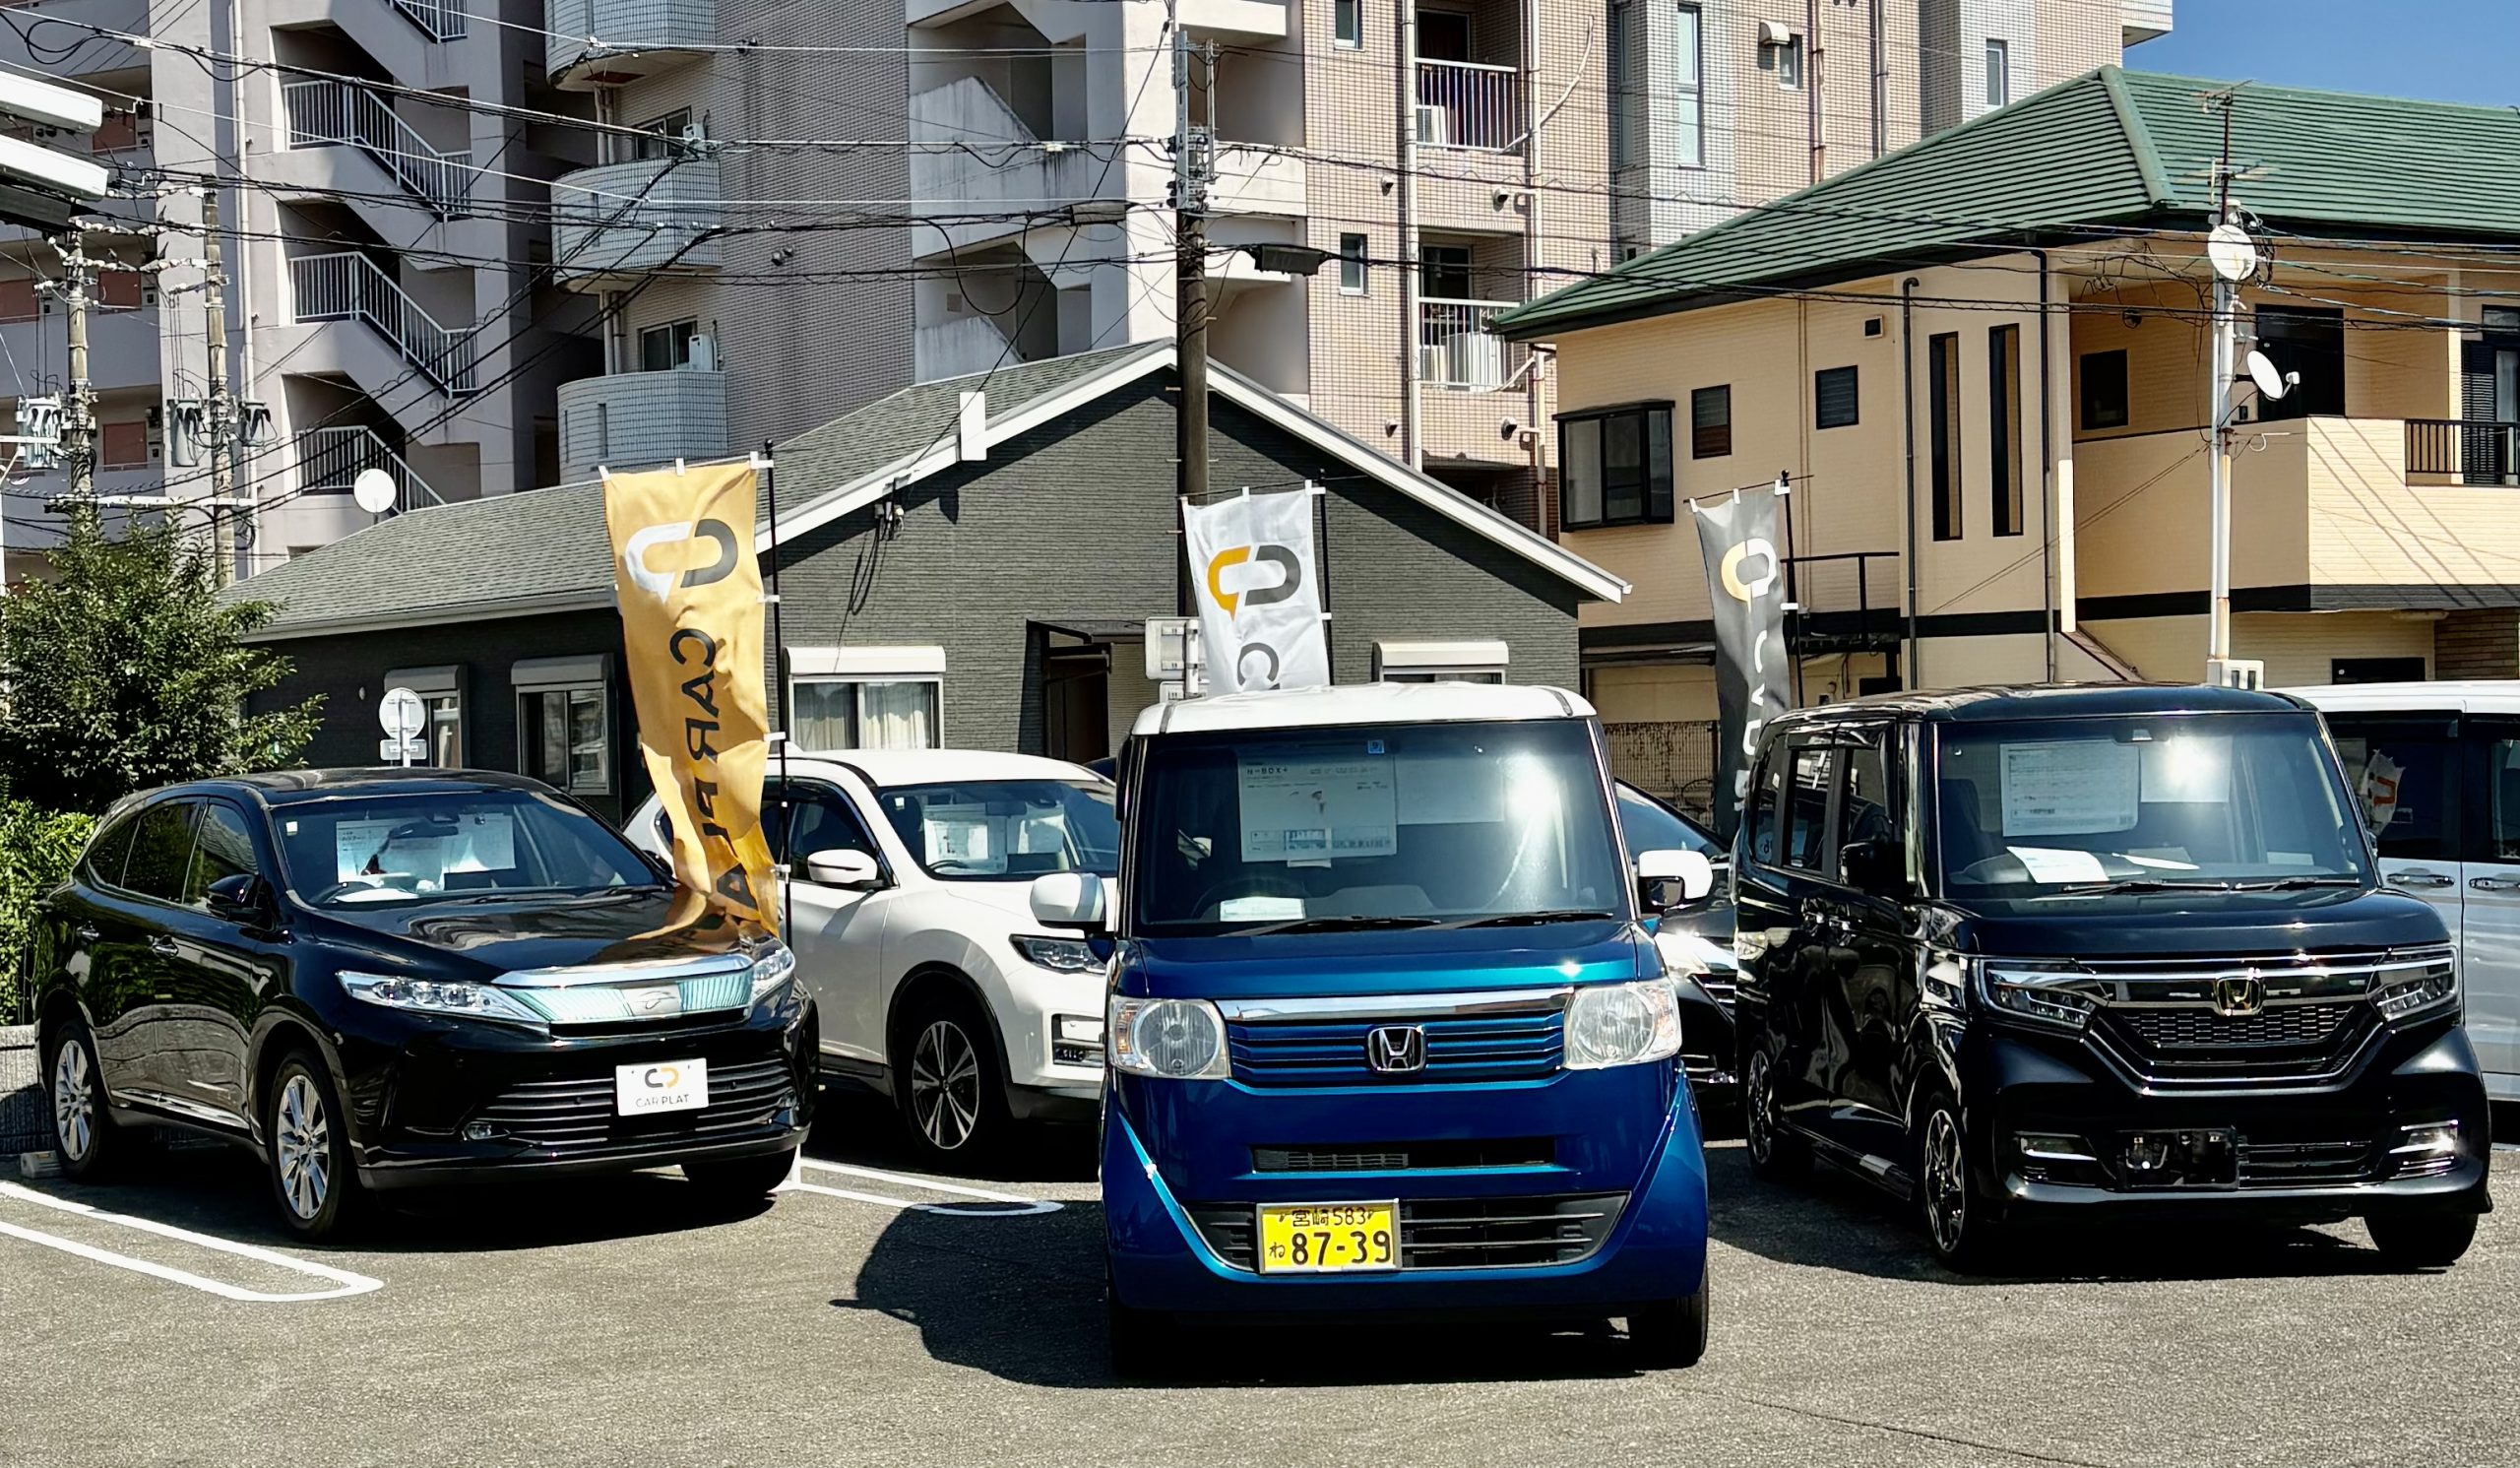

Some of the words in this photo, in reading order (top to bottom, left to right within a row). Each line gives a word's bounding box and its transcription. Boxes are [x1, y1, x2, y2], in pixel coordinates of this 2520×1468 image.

[662, 1094, 689, 1106] PLAT
[1333, 1206, 1366, 1226] 583
[1292, 1230, 1391, 1266] 87-39
